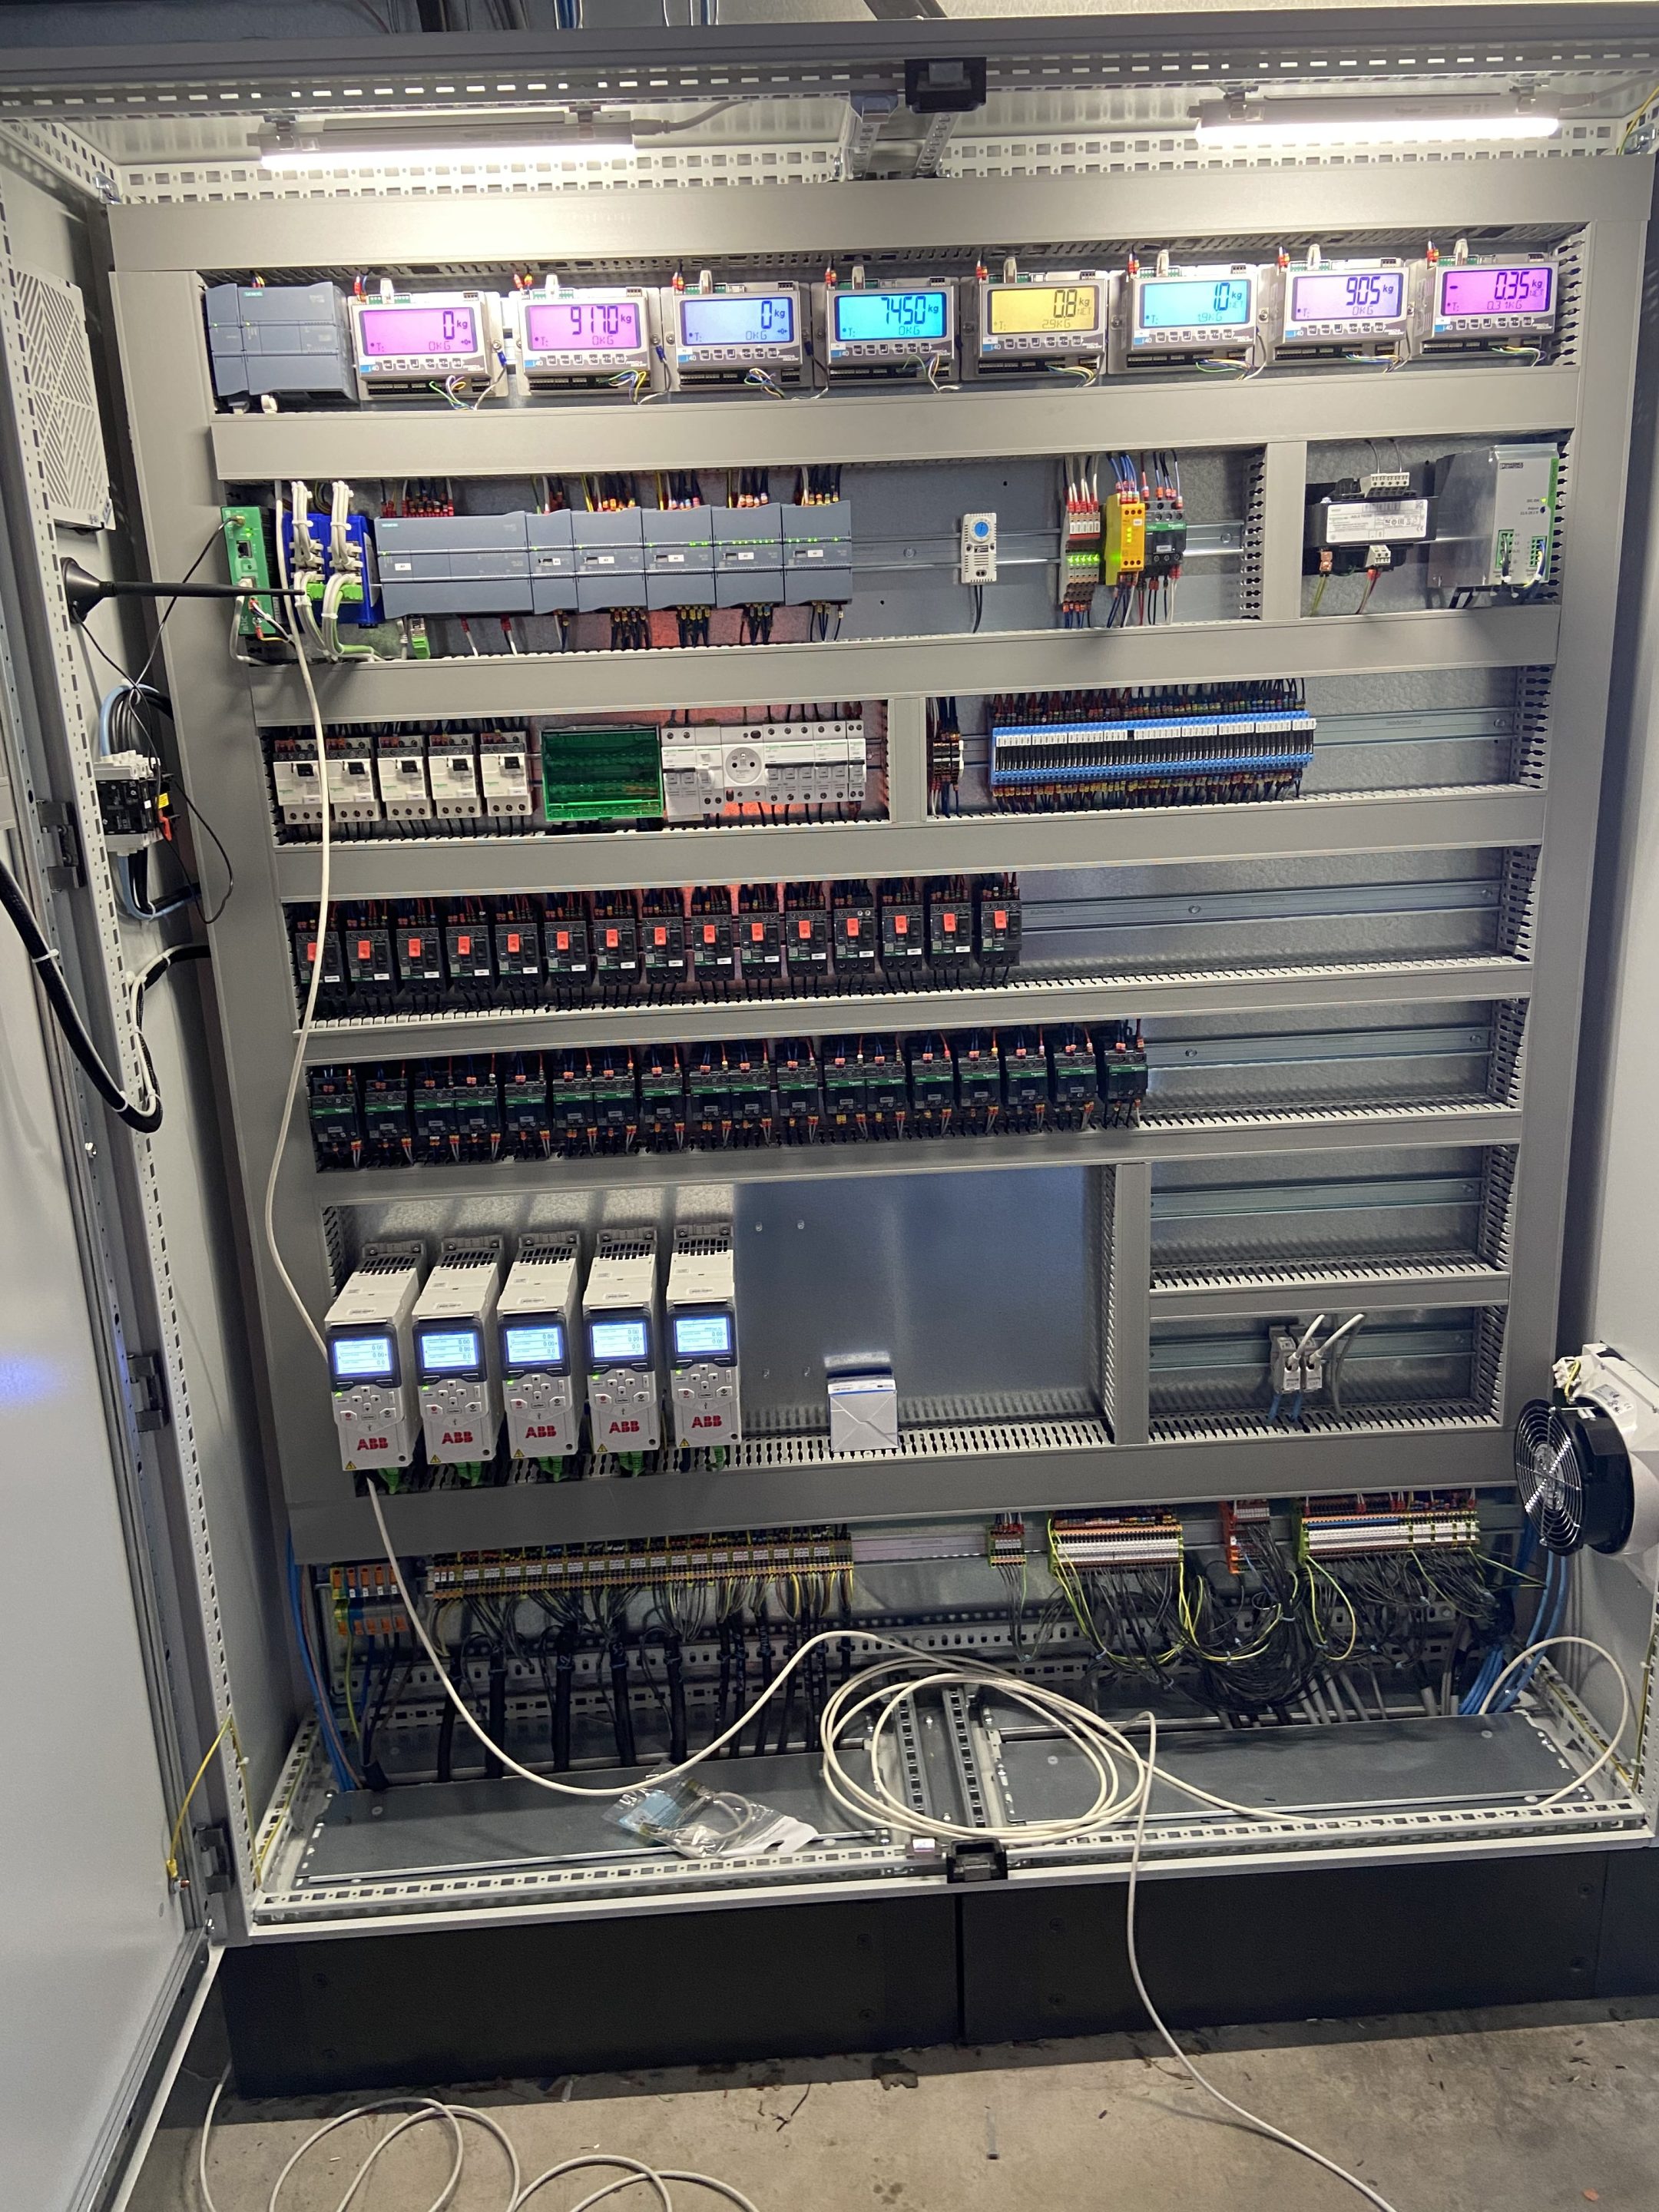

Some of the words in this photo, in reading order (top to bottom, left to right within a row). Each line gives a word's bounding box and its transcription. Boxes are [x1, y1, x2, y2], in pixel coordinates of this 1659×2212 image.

[1231, 291, 1242, 300] kg
[1346, 276, 1381, 306] 905
[1382, 284, 1394, 294] kg
[1494, 271, 1530, 300] 0.35
[1532, 280, 1543, 289] kg
[761, 300, 773, 329] 0
[774, 310, 786, 319] kg
[881, 296, 926, 325] 7450
[928, 304, 939, 314] kg
[1053, 289, 1078, 319] 0.8
[1079, 297, 1091, 306] kg
[443, 311, 455, 339] 0
[456, 320, 468, 329] kg
[571, 305, 618, 335] 9170
[621, 314, 632, 323] kg
[525, 1425, 557, 1439] ABB
[608, 1420, 640, 1434] ABB
[691, 1415, 723, 1429] ABB
[356, 1437, 389, 1451] ABB
[442, 1432, 473, 1445] ABB
